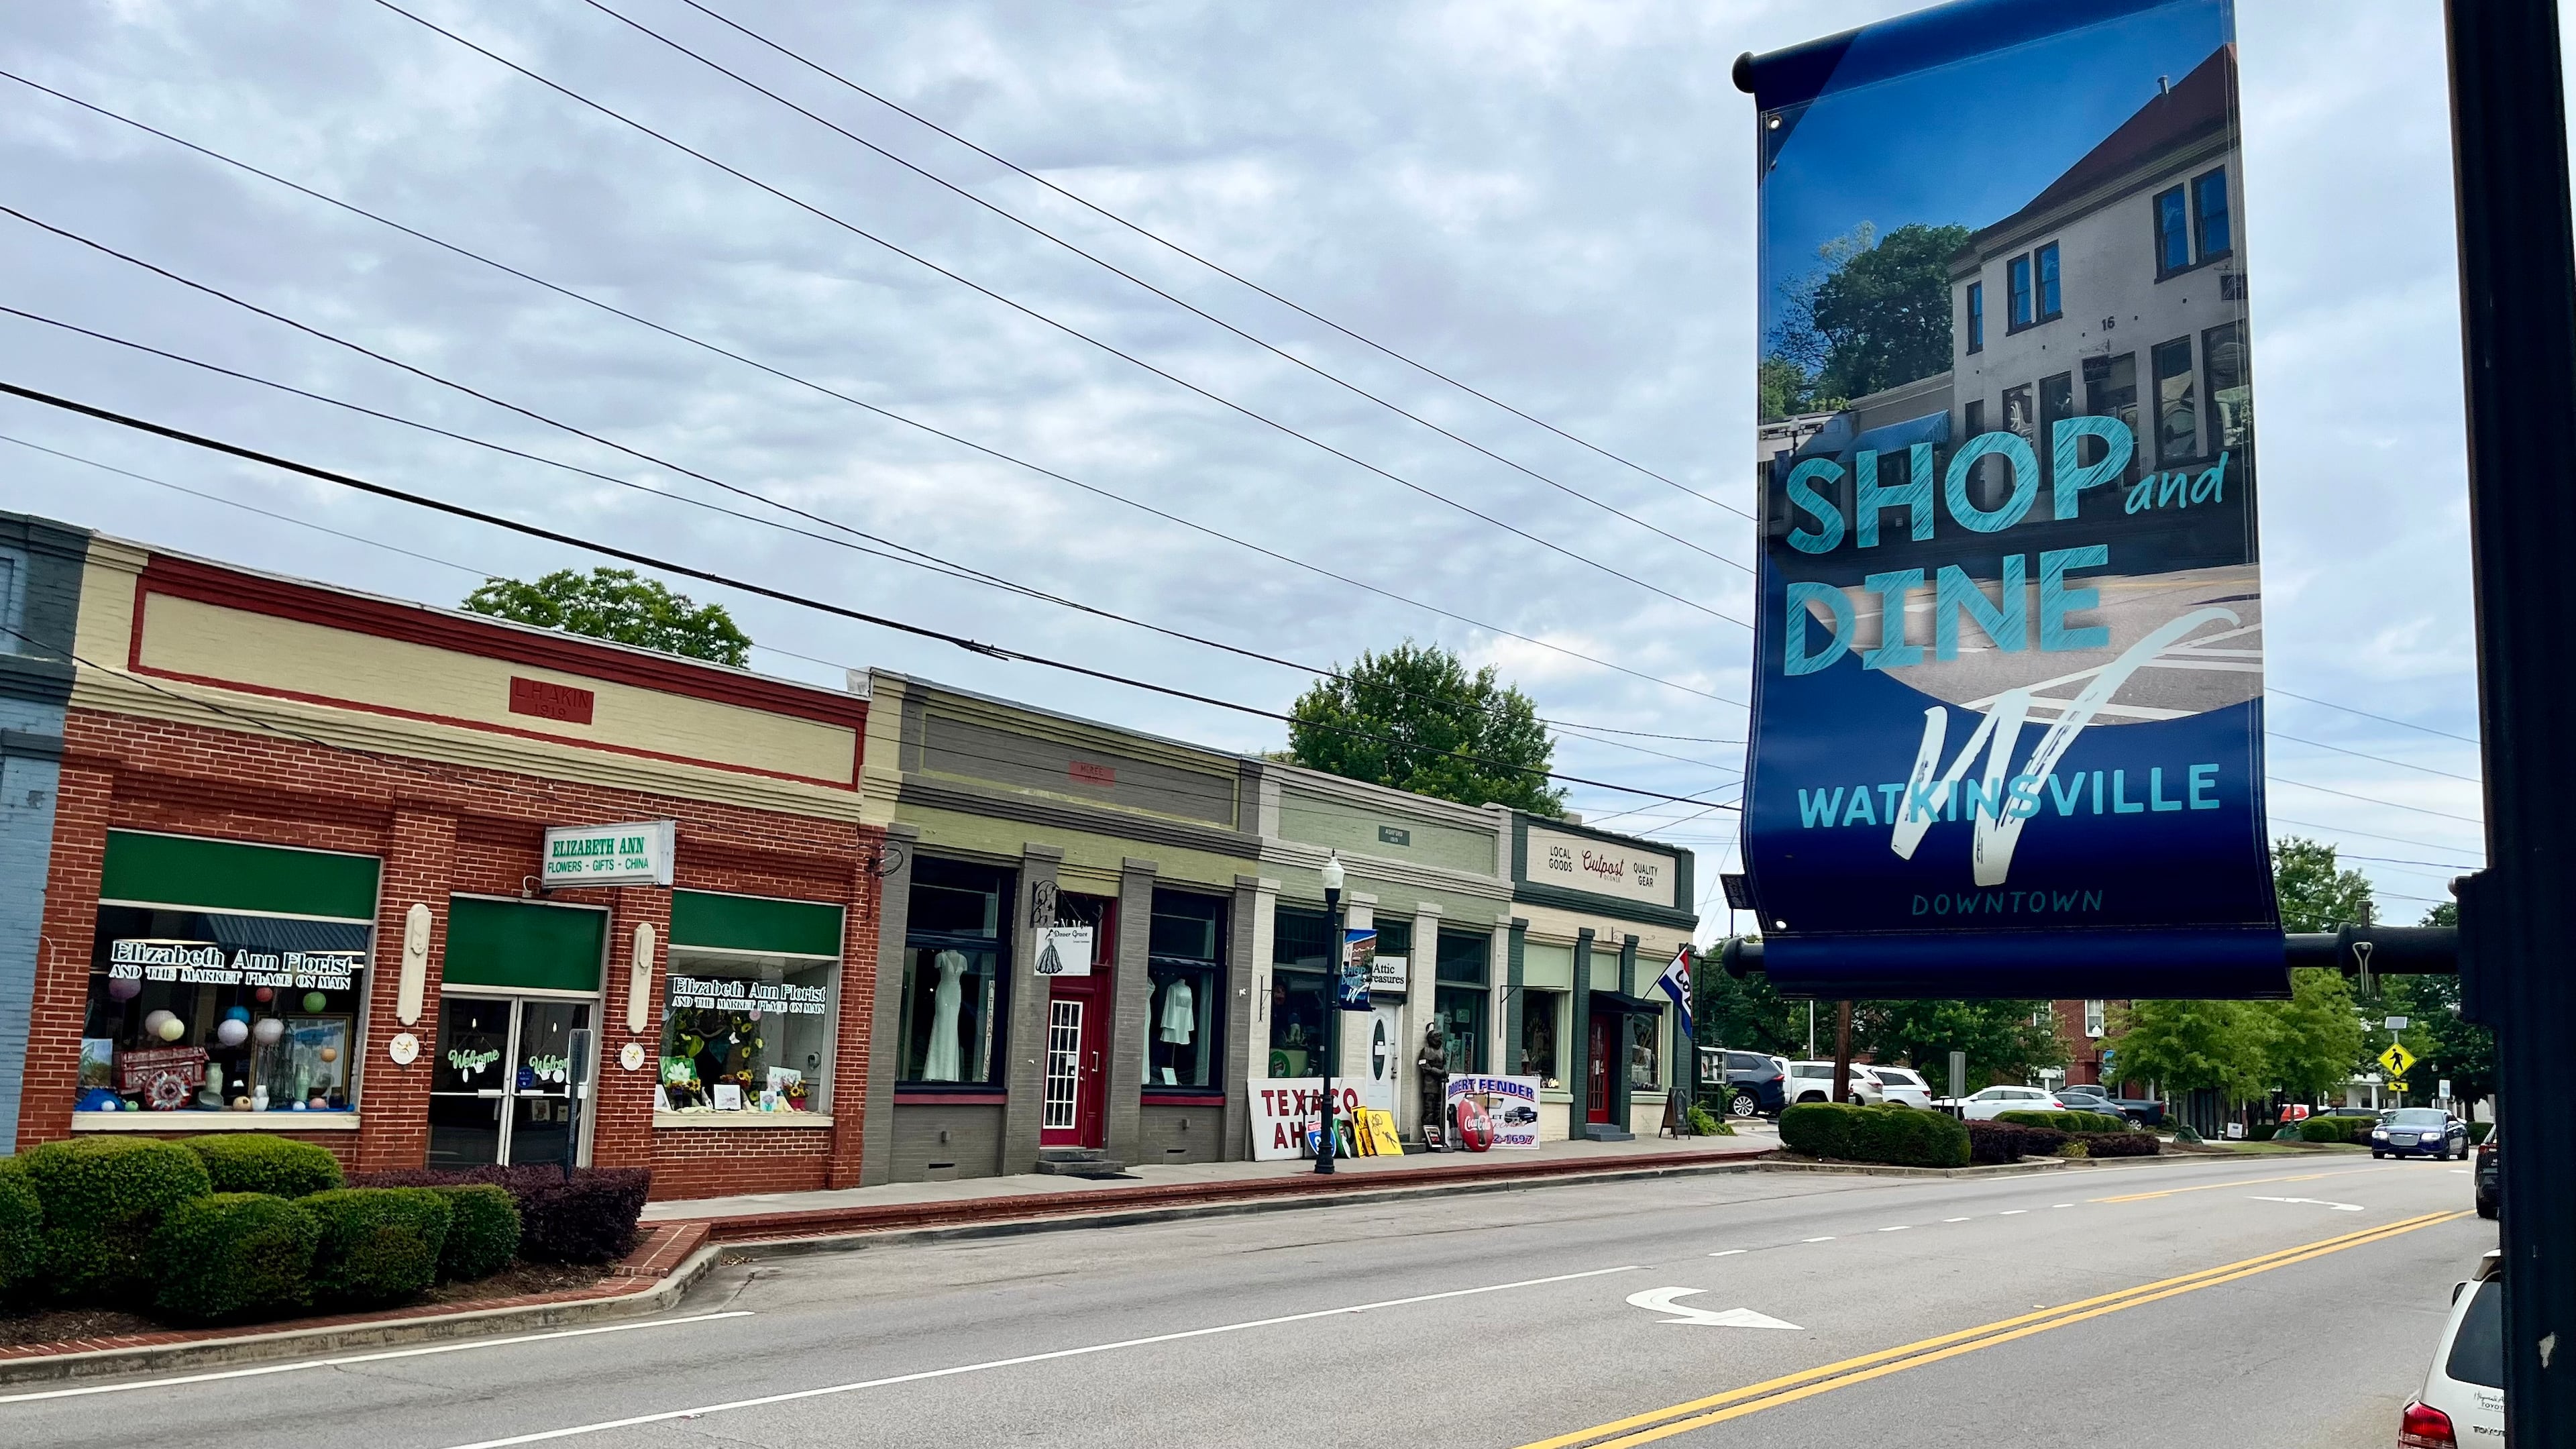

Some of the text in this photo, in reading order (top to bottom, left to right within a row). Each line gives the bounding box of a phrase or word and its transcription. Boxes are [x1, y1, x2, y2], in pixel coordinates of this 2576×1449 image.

[2102, 315, 2115, 331] 16
[1786, 416, 2229, 554] SHOP and
[1784, 544, 2110, 676] DINE
[533, 704, 566, 719] 1919
[1890, 607, 2241, 887] W
[1799, 763, 2220, 828] WATKINSVILLE
[552, 837, 645, 857] ELIZABETH ANN
[1550, 846, 1571, 859] LOCAL
[547, 861, 582, 873] FLOWERS
[592, 859, 614, 871] GIFTS
[625, 858, 649, 870] CHINA
[1549, 858, 1572, 872] GOODS
[1582, 849, 1624, 878] Outpost
[1633, 863, 1658, 876] QUALITY
[1638, 875, 1654, 888] GEAR
[1912, 890, 2104, 916] DOWNTOWN
[111, 941, 353, 975] Elizabeth Ann Florist
[109, 964, 142, 979] AND
[145, 965, 177, 981] THE
[180, 968, 243, 985] MARKET
[296, 974, 316, 988] ON
[317, 975, 351, 990] MAIN
[1373, 963, 1395, 974] Attic
[673, 977, 826, 1002] Elizabeth Ann Florist
[1373, 975, 1404, 984] reasures
[672, 995, 693, 1007] AND
[694, 996, 714, 1009] THE
[716, 998, 756, 1011] MARKET
[789, 1002, 803, 1014] ON
[803, 1003, 826, 1015] MAIN
[448, 1049, 500, 1070] Welcome
[1479, 1079, 1536, 1102] FENDER
[1493, 1134, 1535, 1144] 2-1697
[2481, 1401, 2504, 1410] TOYOT
